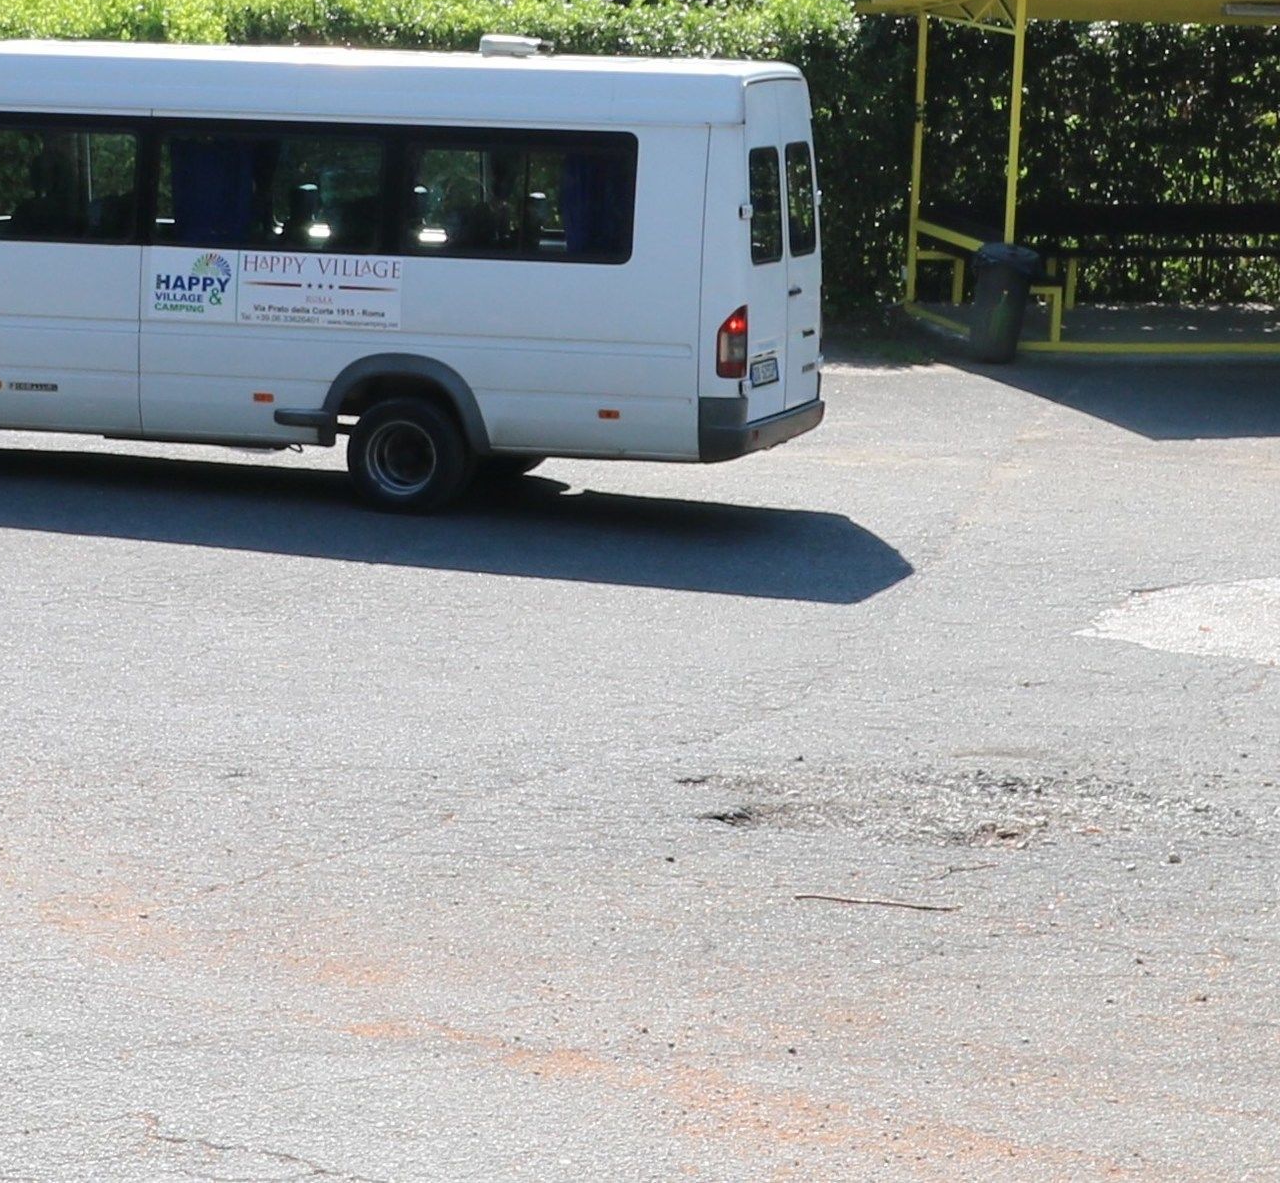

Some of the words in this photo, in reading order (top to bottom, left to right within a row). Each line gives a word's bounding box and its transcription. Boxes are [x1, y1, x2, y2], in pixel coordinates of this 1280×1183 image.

[243, 254, 307, 275] HAPPY
[318, 259, 401, 279] VILLAGE
[155, 274, 231, 292] HAPPY
[154, 292, 203, 303] VILLAGE
[209, 287, 222, 306] &
[154, 302, 205, 313] CAMPING
[253, 304, 266, 312] Via
[268, 305, 290, 313] Prato
[291, 306, 310, 314] della
[362, 310, 386, 318] Roma
